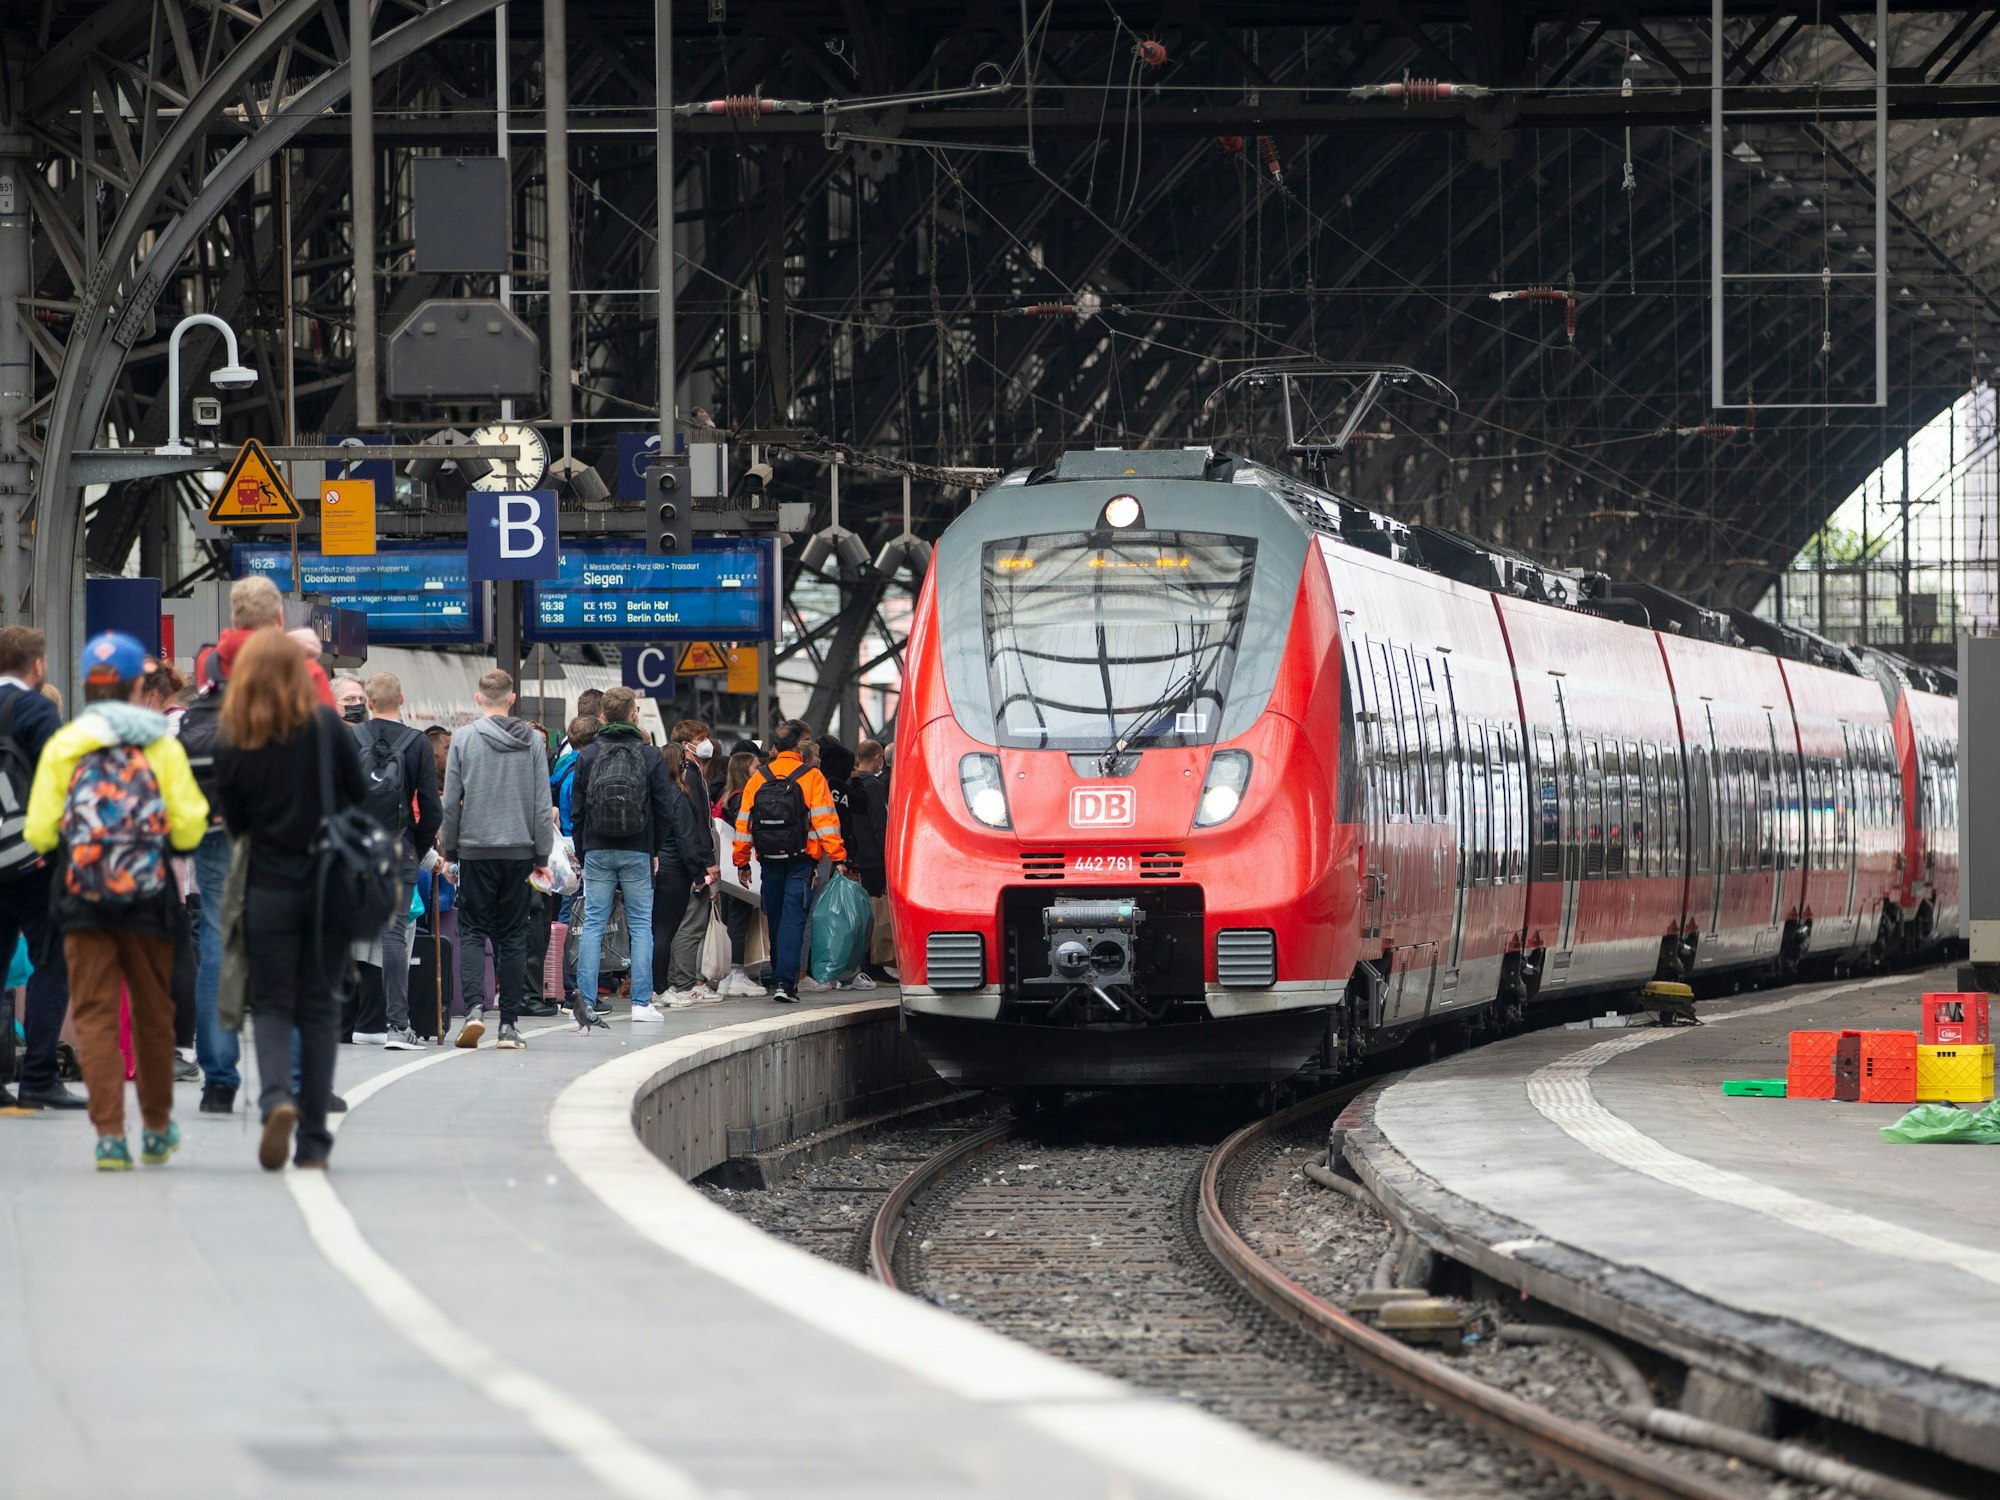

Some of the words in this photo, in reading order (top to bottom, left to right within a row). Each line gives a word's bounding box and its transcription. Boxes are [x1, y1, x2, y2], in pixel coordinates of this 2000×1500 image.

[499, 495, 544, 559] B
[249, 558, 276, 570] 16:25
[345, 565, 372, 574] Opladen
[377, 565, 410, 574] Wuppertal
[590, 563, 631, 571] Messe/Deutz
[637, 563, 652, 571] Porz
[652, 563, 665, 571] (Rh)
[671, 563, 700, 571] Troisdorf
[304, 573, 356, 584] Oberbarmen
[583, 572, 624, 588] Siegen
[362, 595, 382, 604] Hagen
[388, 595, 406, 603] Hamm
[407, 594, 419, 603] (W)
[541, 601, 564, 610] 16:38
[583, 601, 596, 610] ICE
[599, 601, 617, 610] 1153
[627, 601, 651, 610] Berlin
[654, 601, 669, 610] Hbf
[541, 613, 564, 622] 16:38
[583, 613, 596, 622] ICE
[599, 613, 617, 622] 1153
[627, 613, 651, 622] Berlin
[654, 613, 680, 622] Ostbf.
[637, 647, 667, 688] C
[1077, 792, 1129, 822] DB
[1075, 856, 1104, 872] 442
[1107, 856, 1133, 872] 761
